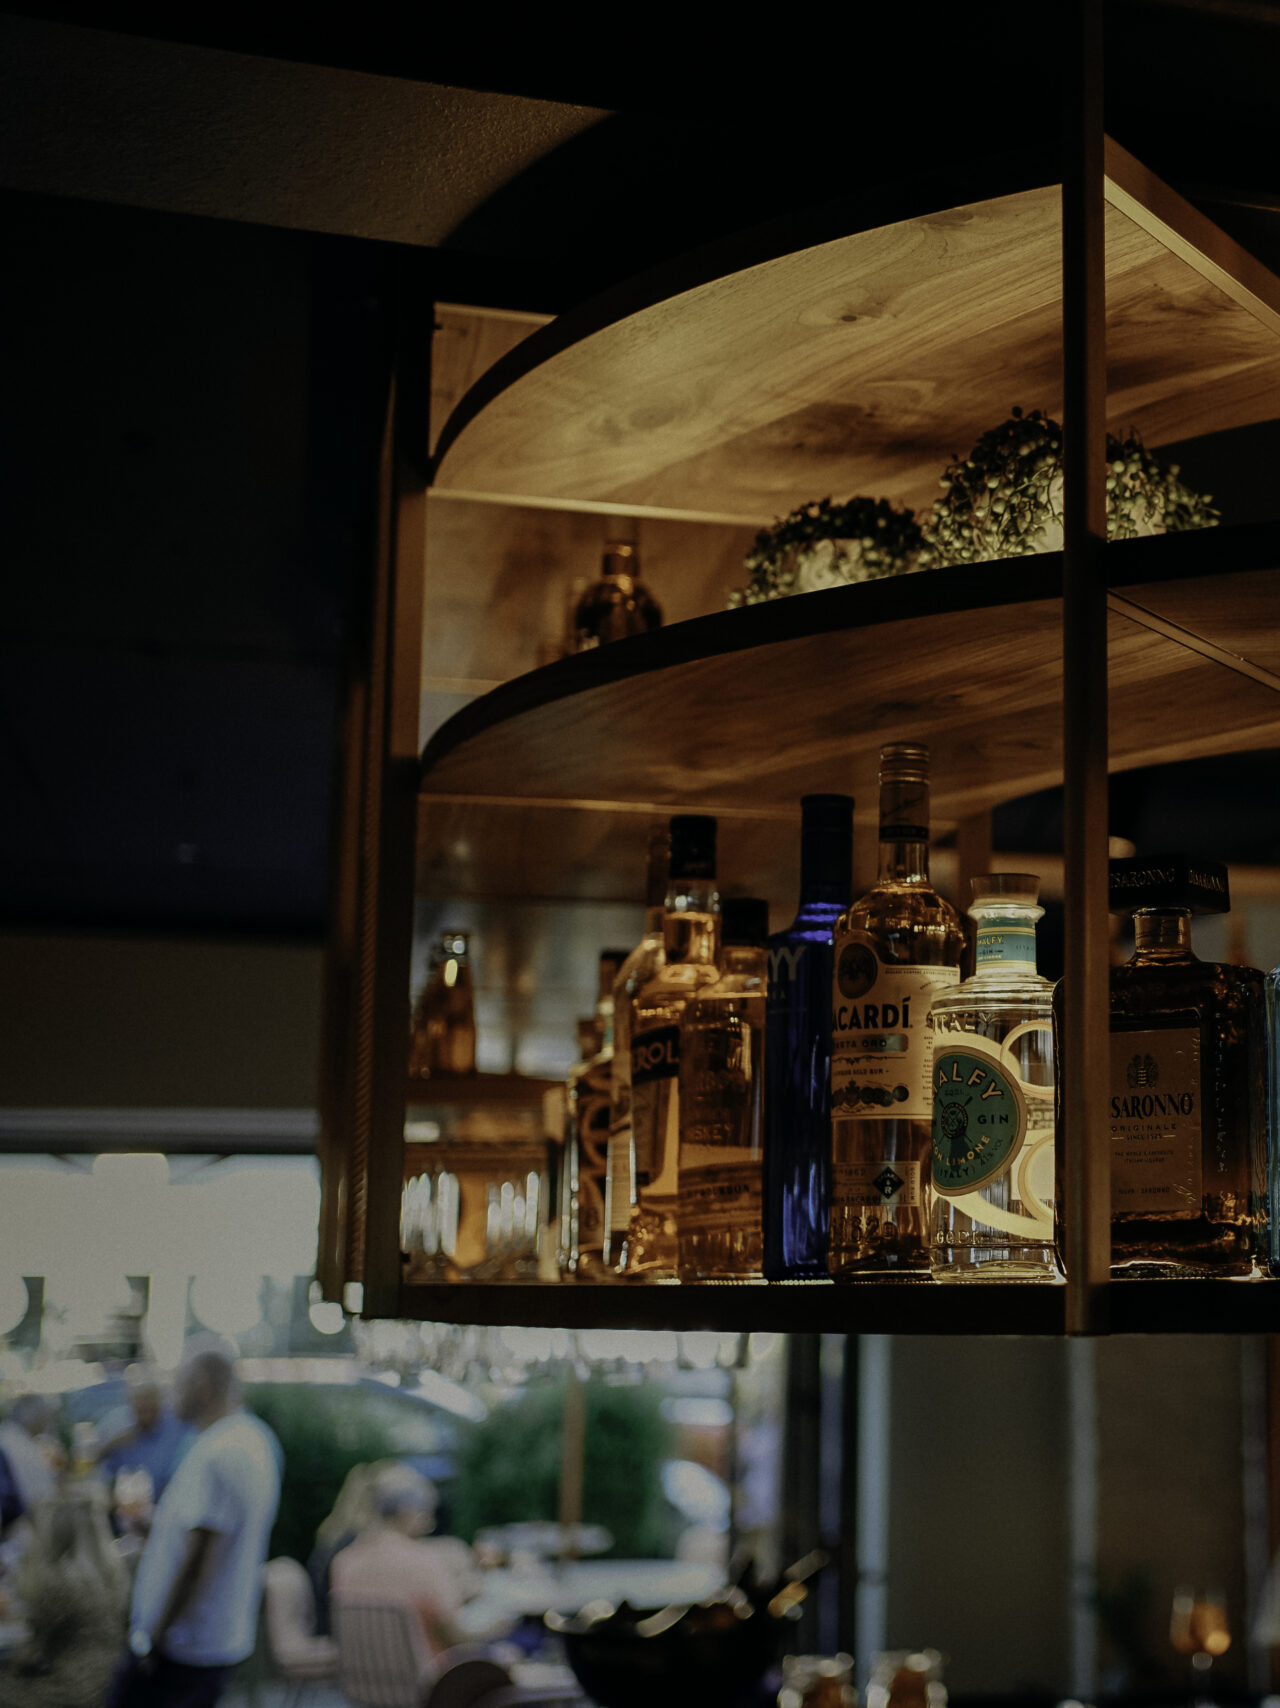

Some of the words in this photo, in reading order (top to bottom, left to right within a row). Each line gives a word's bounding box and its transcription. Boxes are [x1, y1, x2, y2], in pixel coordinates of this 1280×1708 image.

[1112, 1093, 1193, 1119] SARONNO
[977, 1114, 1009, 1125] GIN
[1112, 1123, 1177, 1132] ORIGINALE
[945, 1136, 990, 1166] LIMONE
